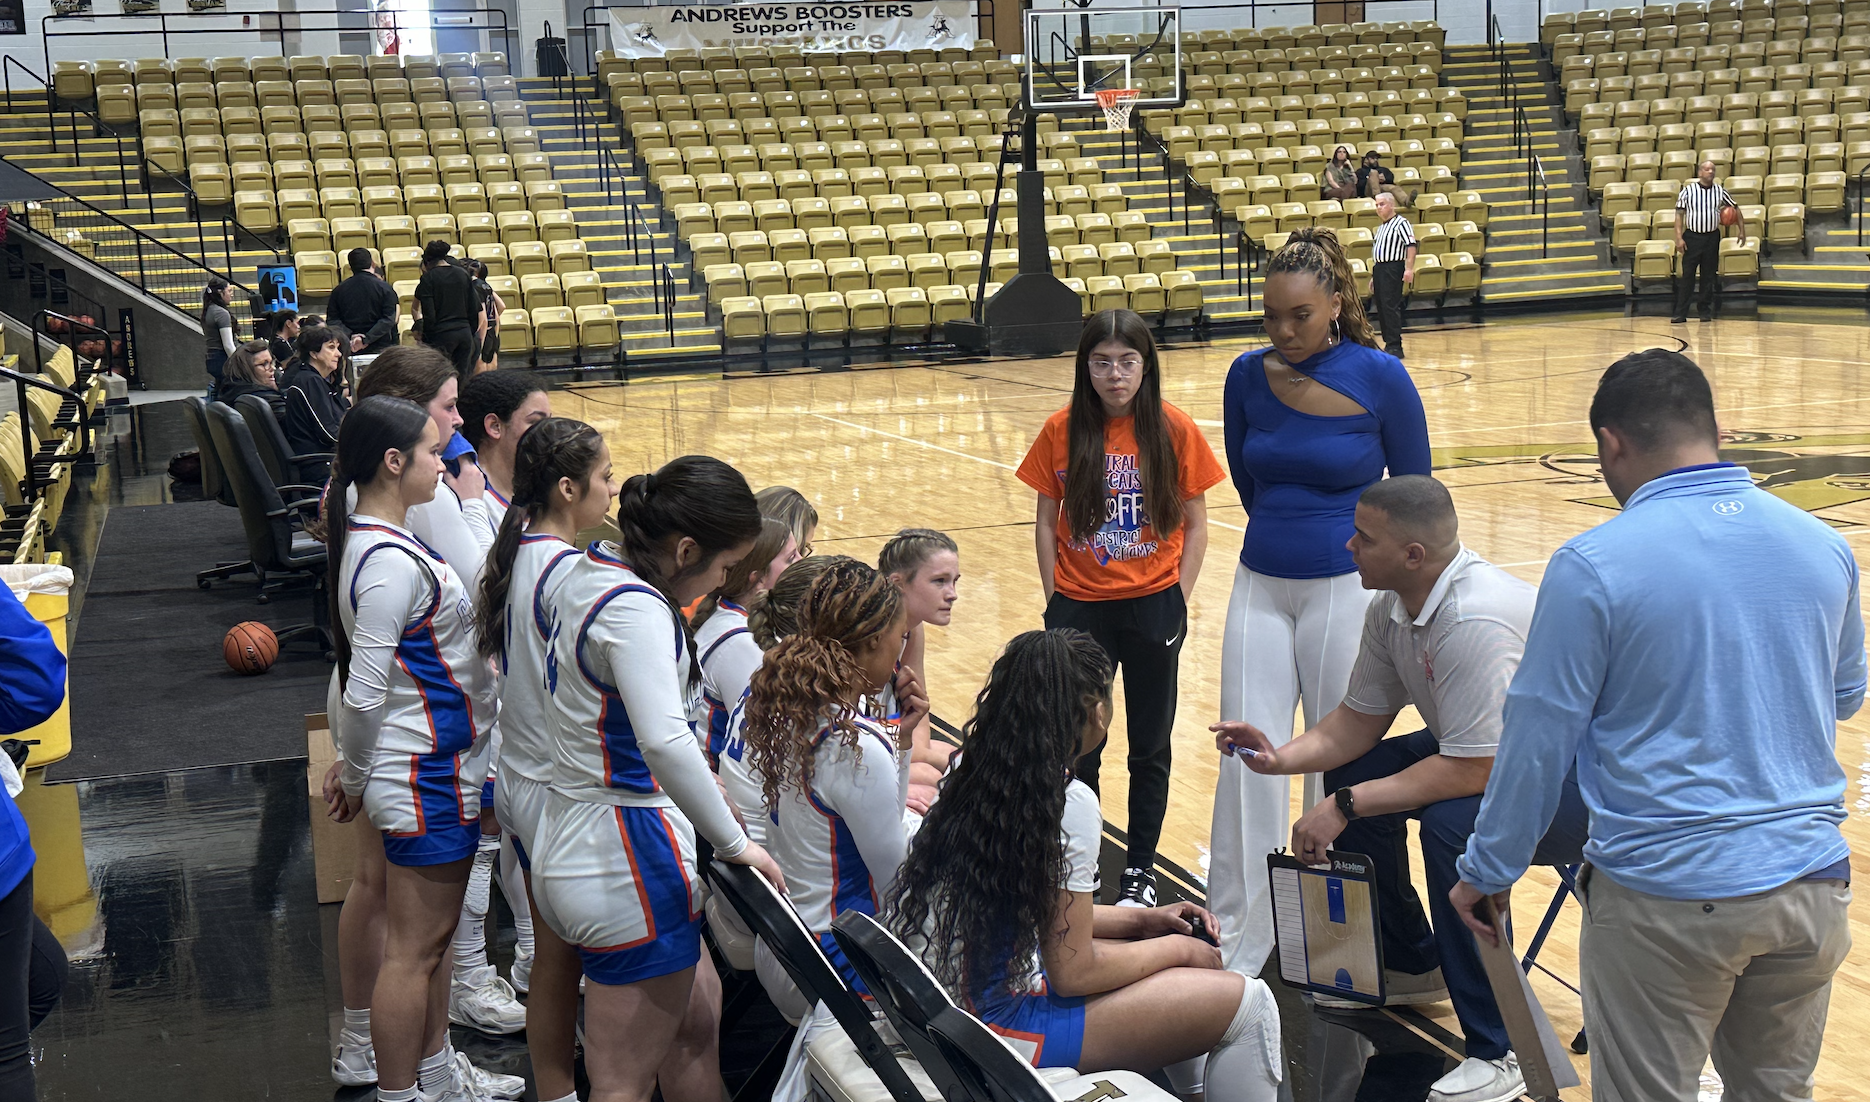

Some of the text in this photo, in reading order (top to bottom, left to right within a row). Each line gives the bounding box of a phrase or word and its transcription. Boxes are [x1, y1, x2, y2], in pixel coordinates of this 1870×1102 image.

[671, 4, 913, 23] ANDREWS BOOSTERS
[732, 20, 856, 36] Support The
[1105, 454, 1140, 471] TRAL
[1108, 472, 1142, 489] CATS
[1094, 528, 1142, 548] DISTRICT
[1112, 541, 1158, 561] CHAMPS
